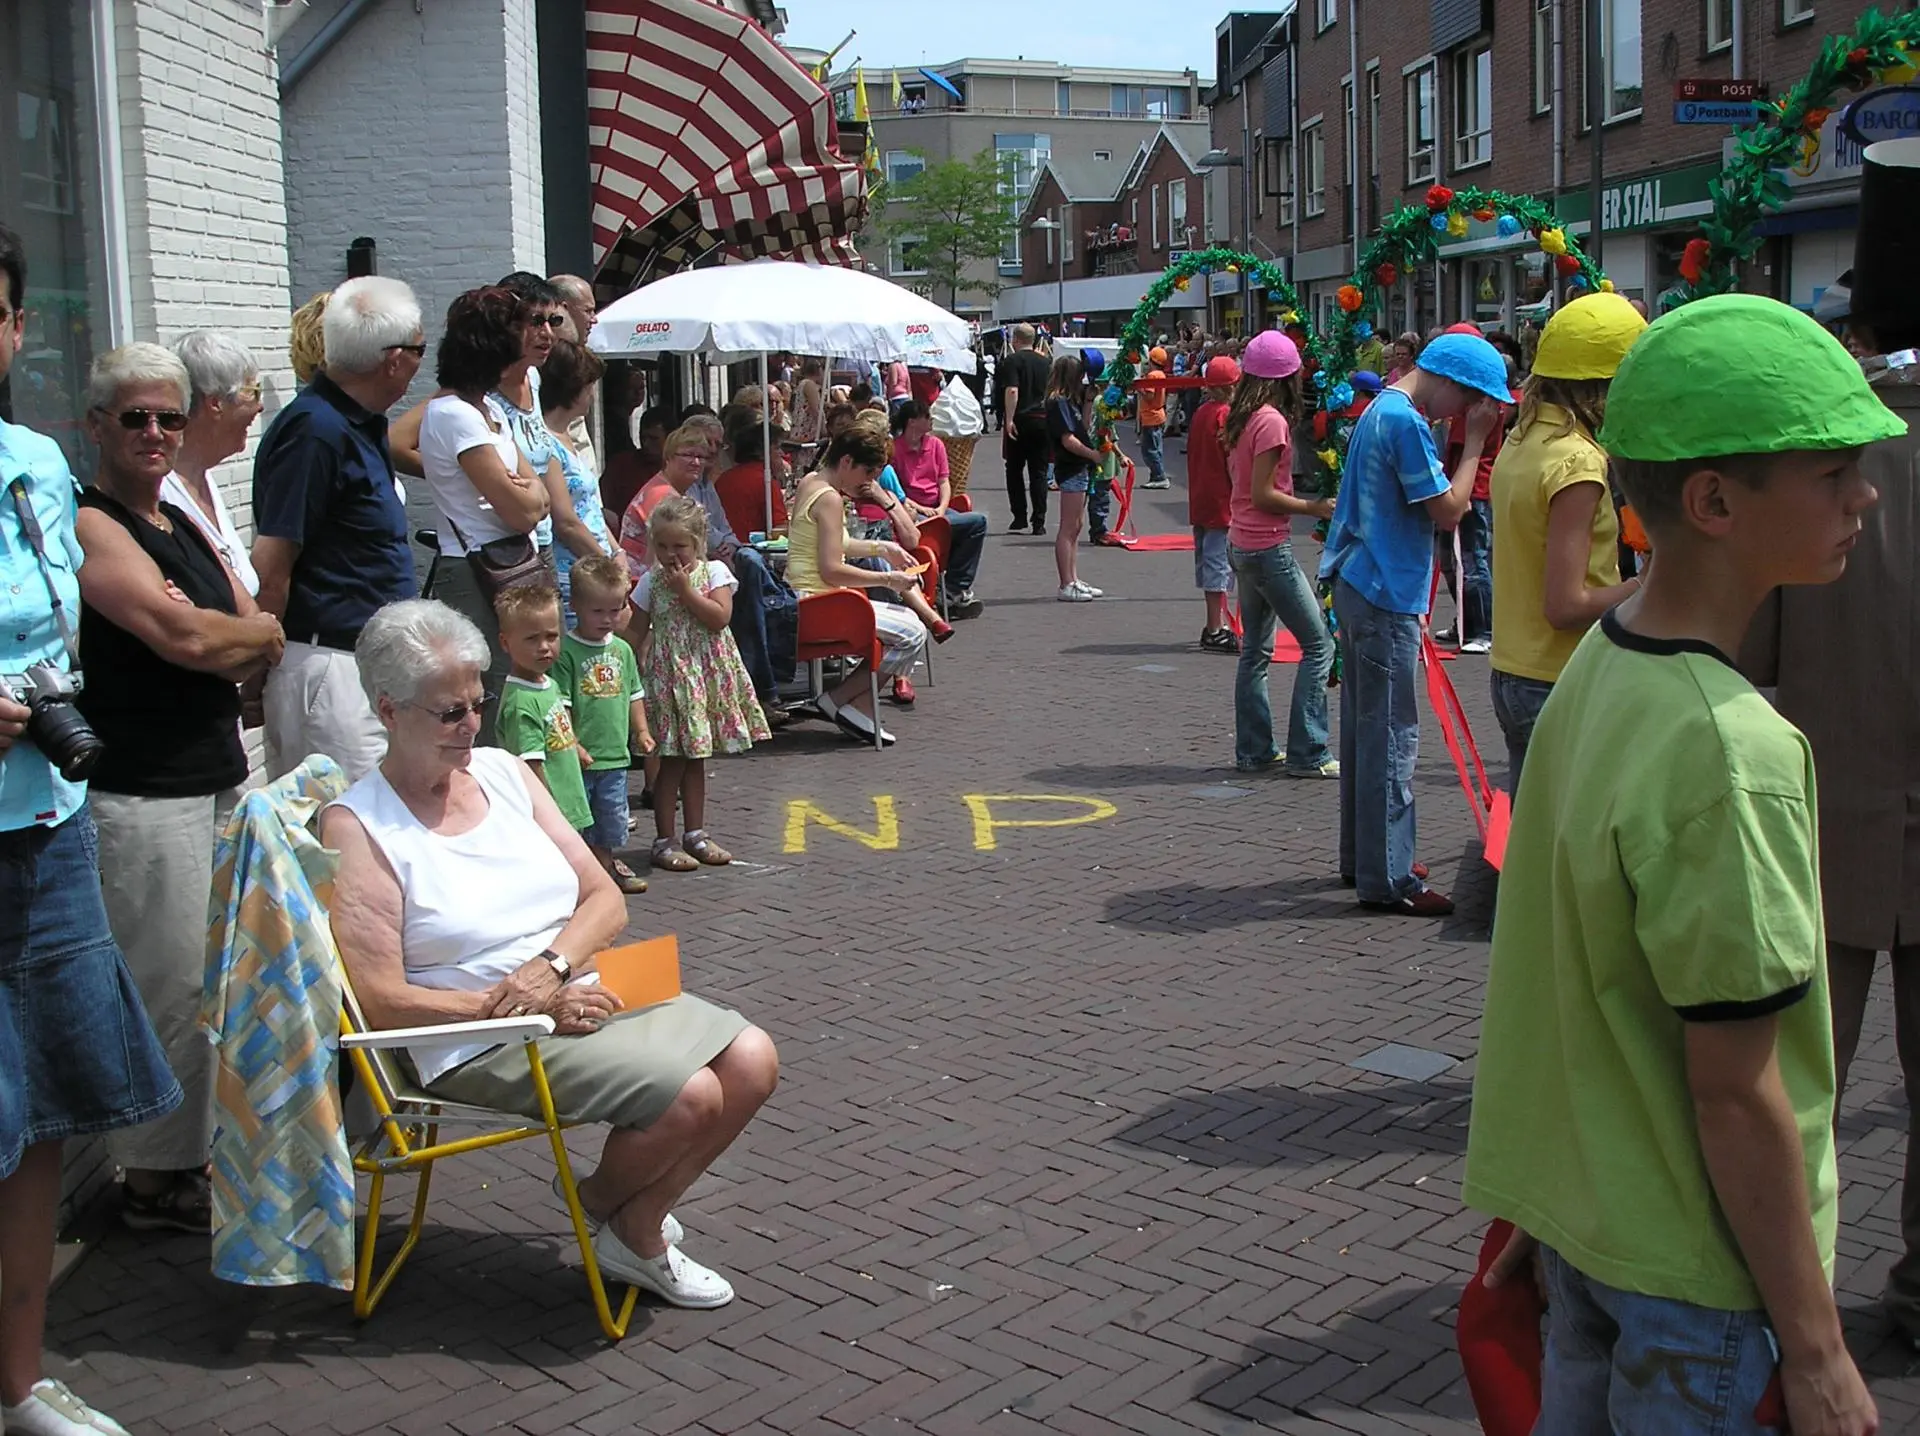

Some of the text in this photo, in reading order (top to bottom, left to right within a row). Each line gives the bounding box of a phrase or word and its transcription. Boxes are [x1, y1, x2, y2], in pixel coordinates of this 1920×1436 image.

[1721, 84, 1753, 96] POST
[1698, 105, 1753, 118] Postbank
[636, 321, 670, 333] GELATO
[597, 666, 615, 682] 53
